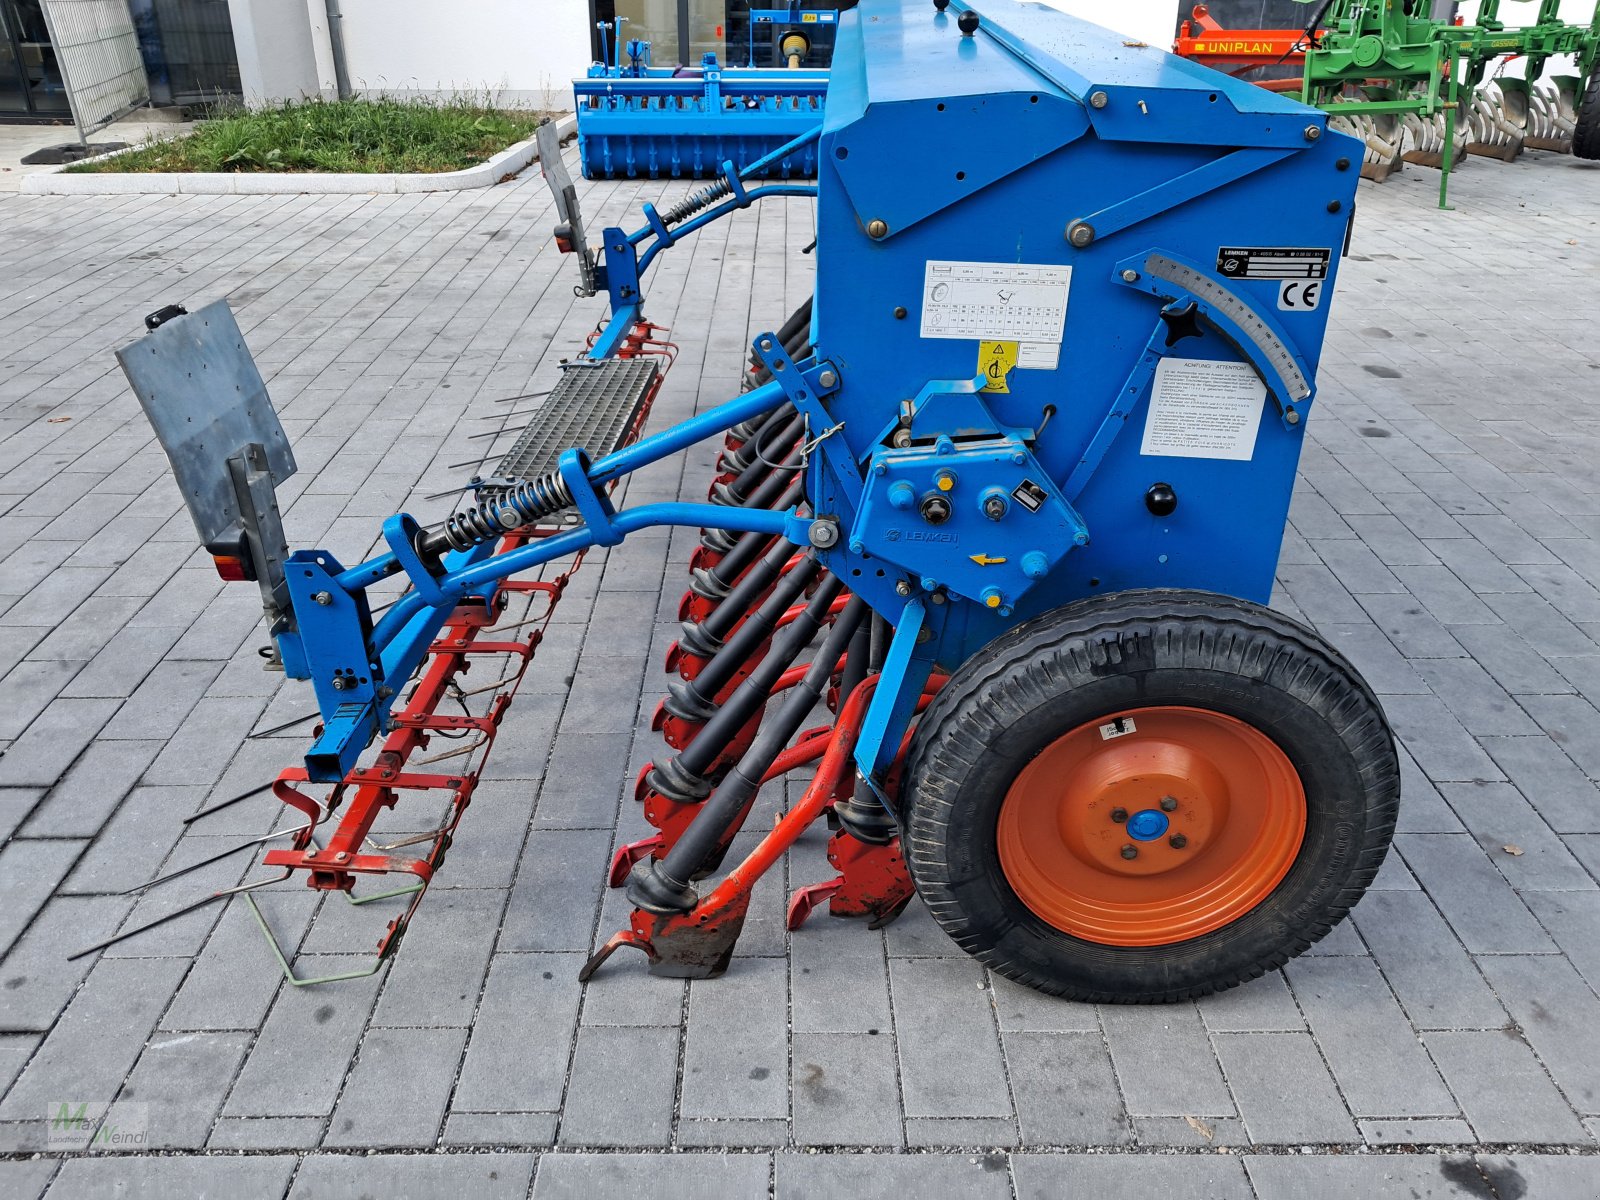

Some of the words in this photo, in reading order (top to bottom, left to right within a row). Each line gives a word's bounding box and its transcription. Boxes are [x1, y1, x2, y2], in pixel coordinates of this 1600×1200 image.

[1208, 42, 1273, 53] UNIPLAN
[1282, 282, 1319, 308] CE
[1215, 363, 1247, 371] ATTENTION!
[905, 531, 960, 544] LEMKEN
